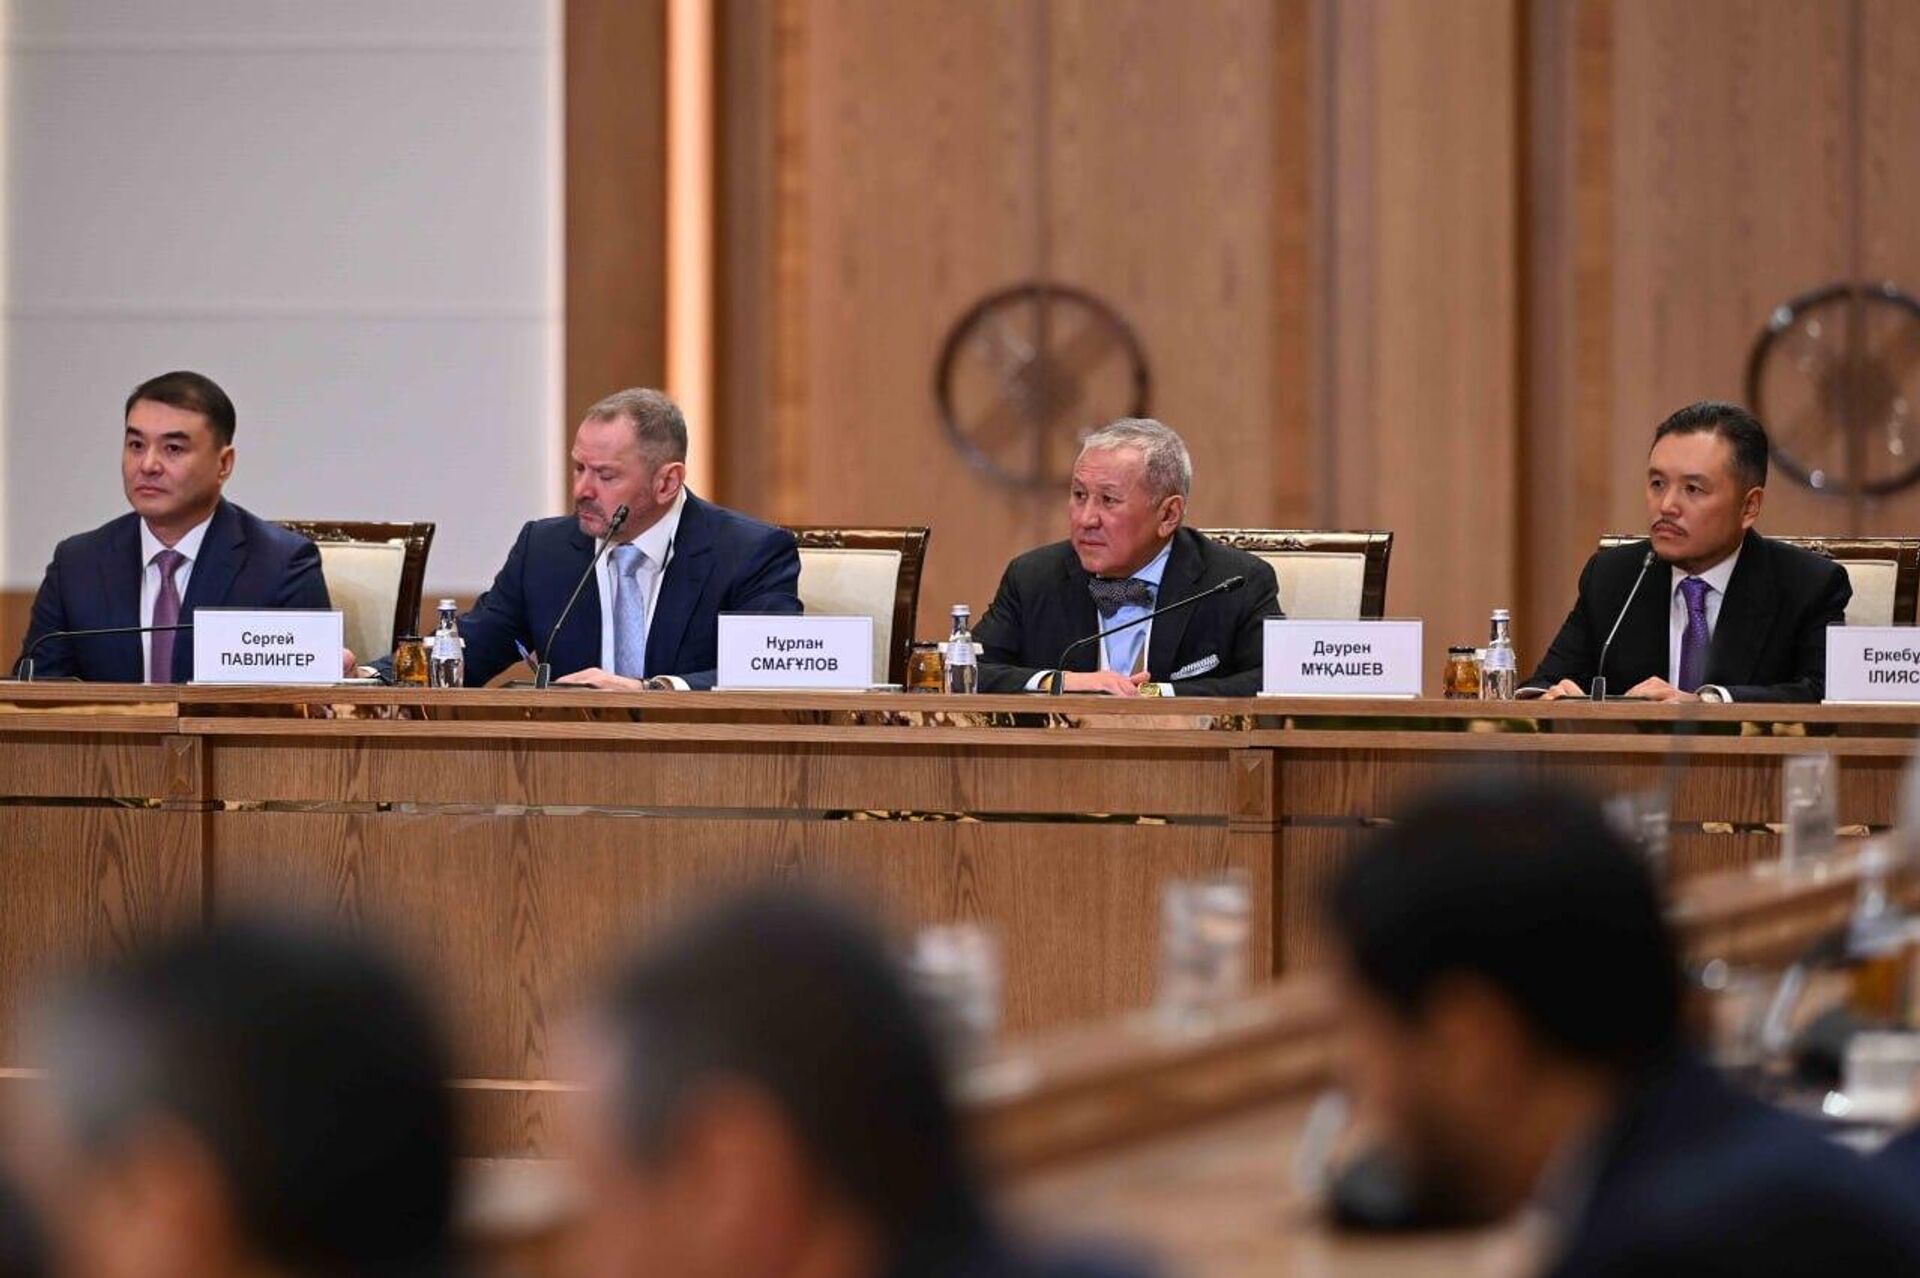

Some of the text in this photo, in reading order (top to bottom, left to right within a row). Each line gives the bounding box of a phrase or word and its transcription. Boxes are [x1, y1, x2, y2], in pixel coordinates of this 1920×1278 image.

[241, 631, 295, 648] Сергей
[766, 636, 824, 652] Нұрлан
[1313, 640, 1372, 657] Дәурен
[221, 652, 316, 667] ПАВЛИНГЕР
[750, 657, 839, 671] СМАҒҰЛОВ
[1301, 662, 1384, 678] МҰҚАШЕВ
